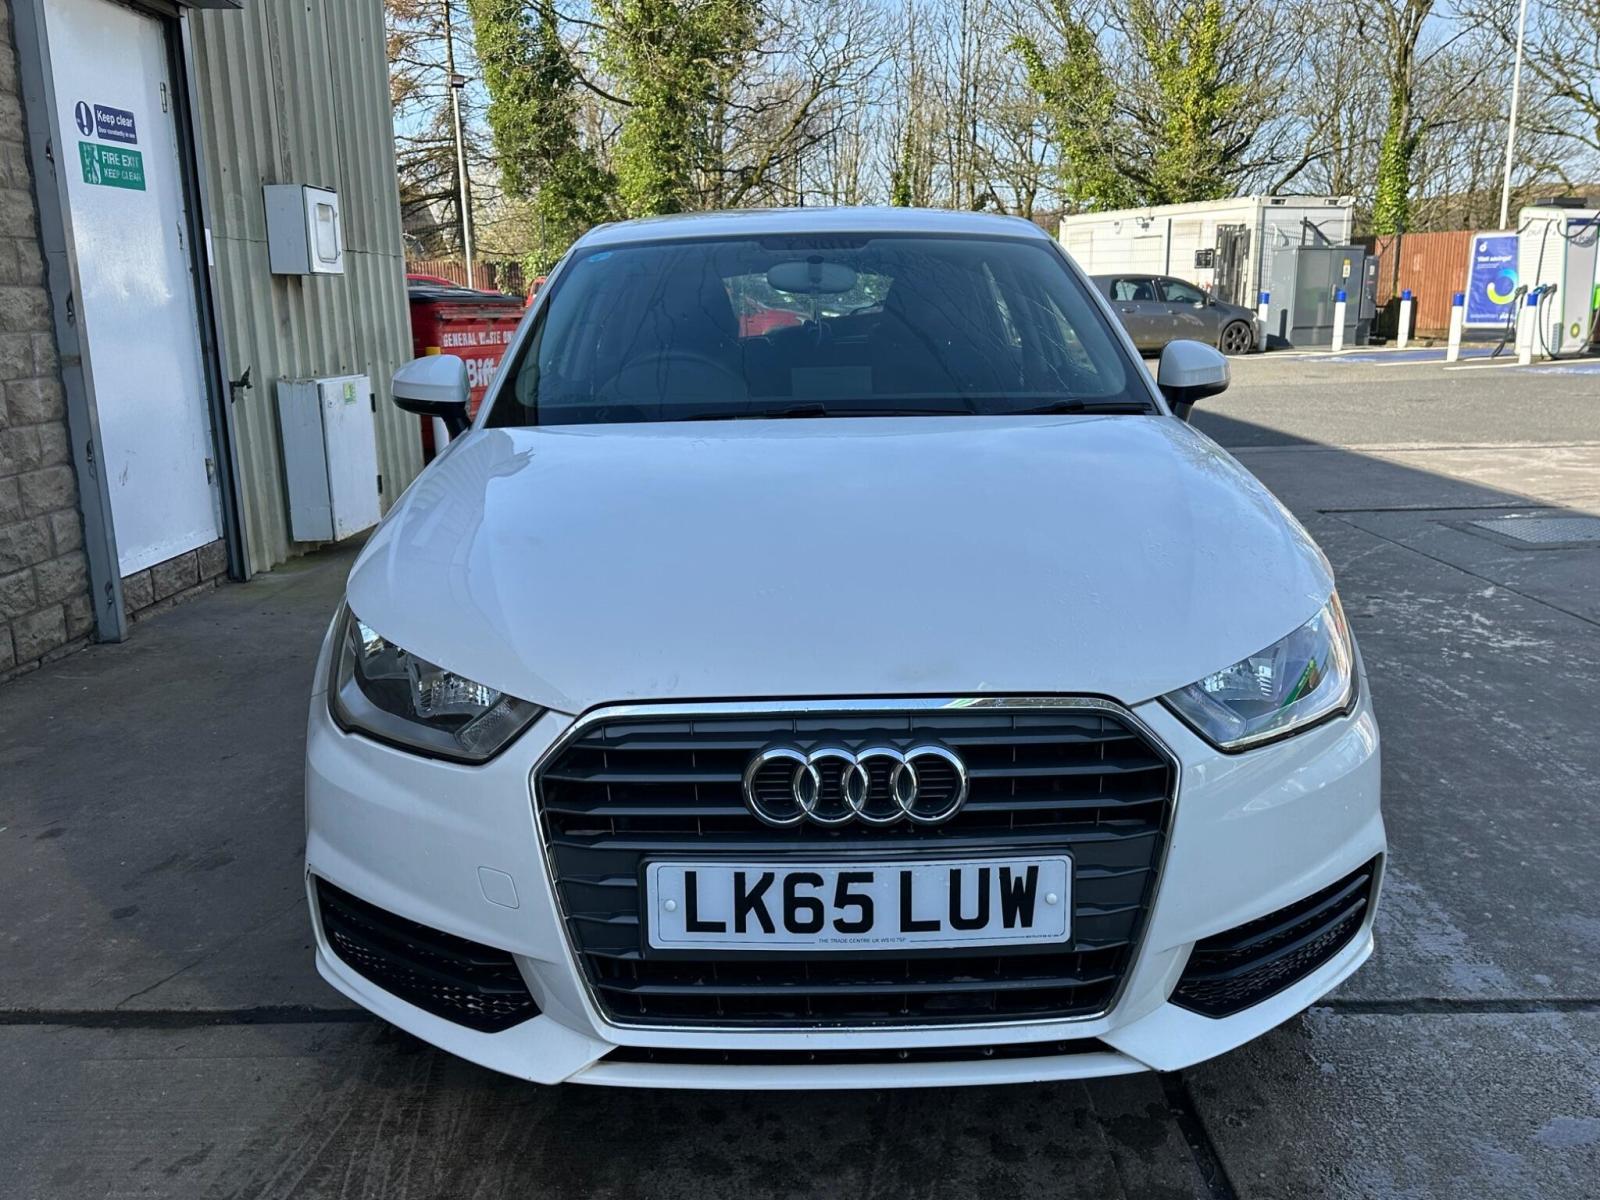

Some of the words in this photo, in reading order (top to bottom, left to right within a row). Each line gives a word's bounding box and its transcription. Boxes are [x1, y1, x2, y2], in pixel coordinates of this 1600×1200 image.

[97, 110, 115, 126] Keep
[116, 115, 132, 127] clear
[102, 151, 121, 166] FIRE
[104, 167, 120, 179] KEEP
[443, 333, 477, 347] GENERAL
[684, 870, 874, 935] LK65
[899, 865, 1039, 931] LUW
